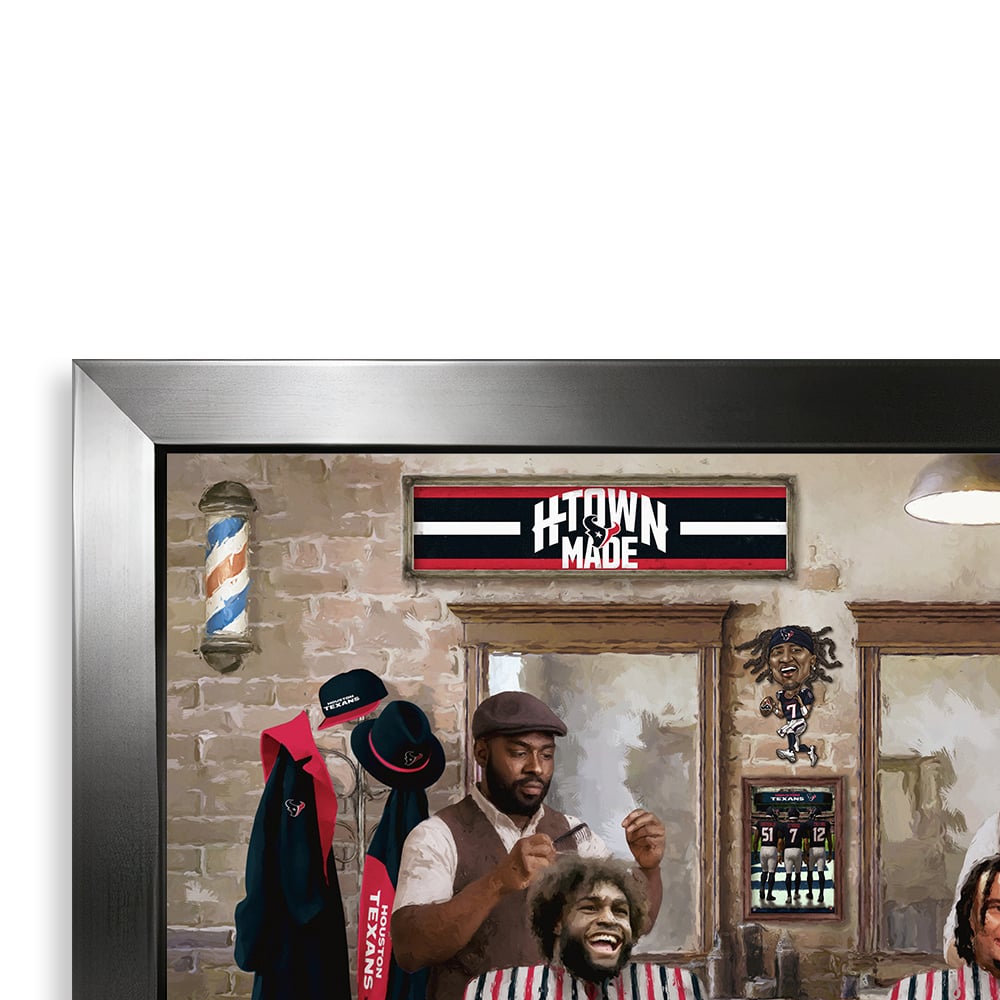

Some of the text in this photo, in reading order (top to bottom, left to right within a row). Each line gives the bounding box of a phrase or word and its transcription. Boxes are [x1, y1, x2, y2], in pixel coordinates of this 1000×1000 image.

[562, 536, 639, 569] MADE
[323, 696, 361, 711] TEXANS
[786, 703, 797, 719] 7
[761, 827, 774, 842] 51
[789, 828, 798, 843] 7
[813, 827, 826, 842] 12
[363, 890, 381, 990] TEXANS
[375, 905, 389, 979] HOUSTON
